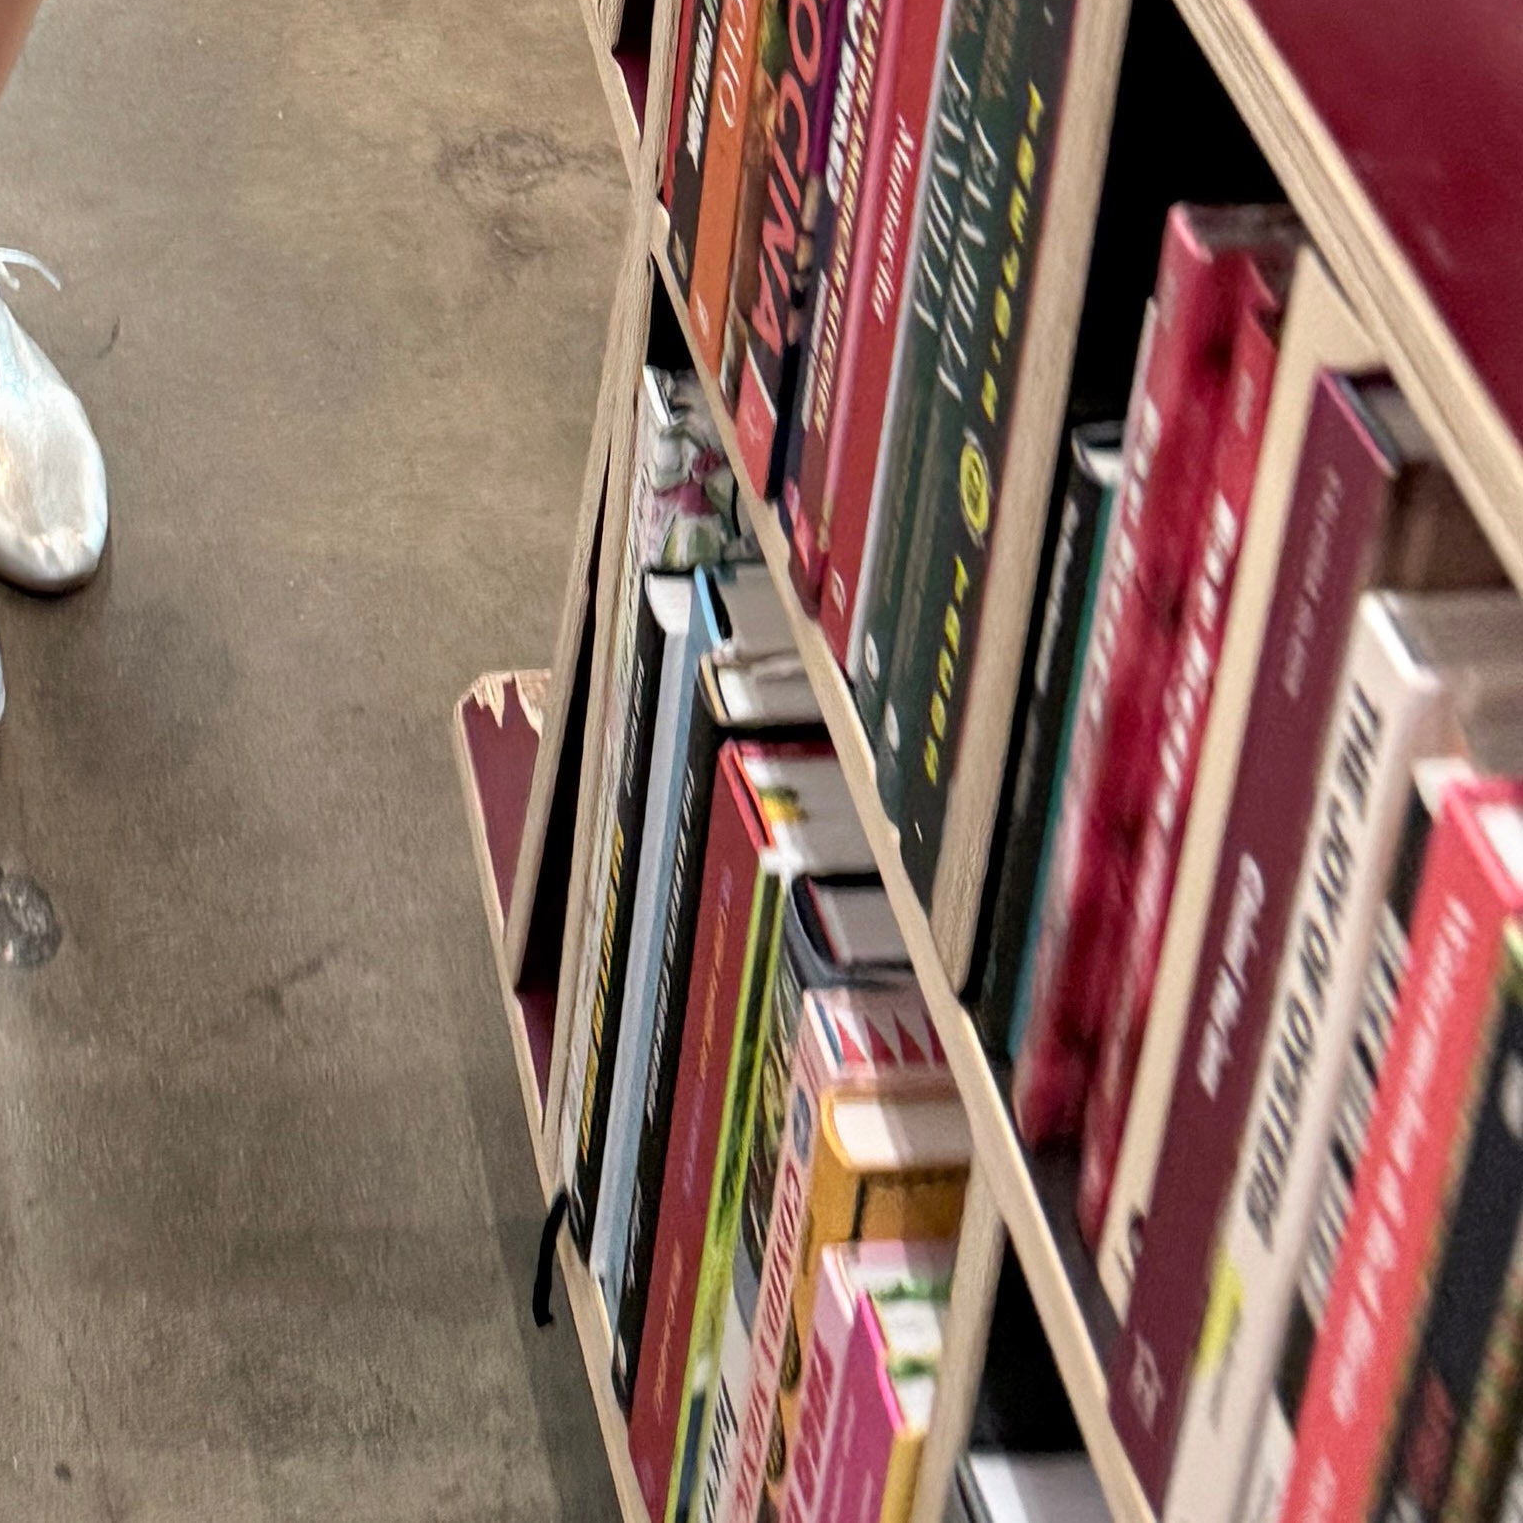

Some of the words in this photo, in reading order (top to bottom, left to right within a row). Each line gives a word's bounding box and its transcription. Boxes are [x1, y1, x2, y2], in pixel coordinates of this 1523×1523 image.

[855, 10, 880, 114] LATIN
[832, 112, 865, 291] AMERICAN
[873, 113, 914, 326] Mamacita
[913, 53, 971, 332] FAMILIA
[937, 114, 999, 403] FAMILIA
[813, 289, 843, 443] KITCHEN
[924, 555, 968, 786] TACOS
[1337, 679, 1381, 815] THE
[1314, 798, 1355, 925] JOY
[1296, 910, 1330, 1005] OF
[1244, 988, 1313, 1253] OYSTERS
